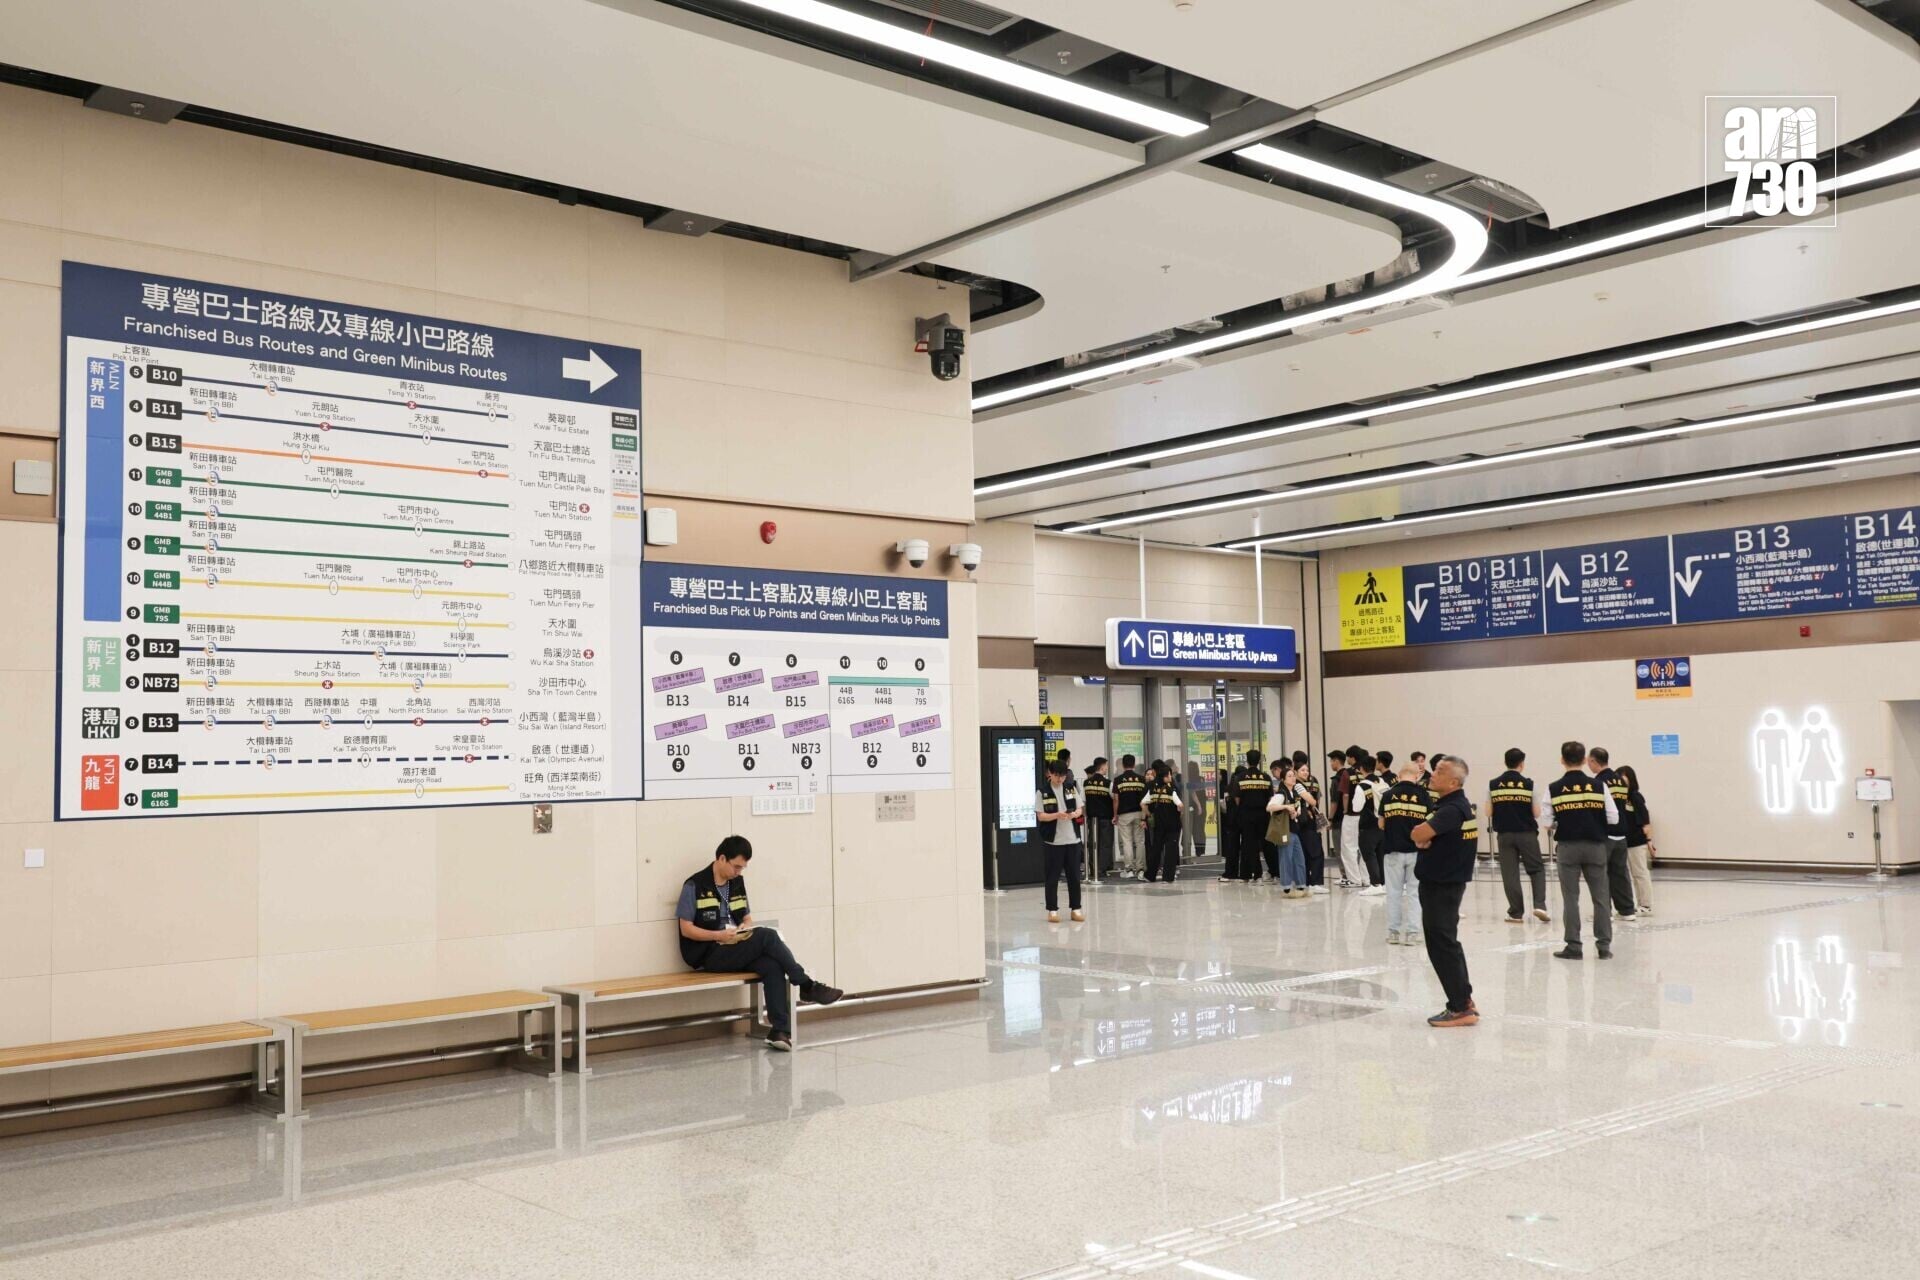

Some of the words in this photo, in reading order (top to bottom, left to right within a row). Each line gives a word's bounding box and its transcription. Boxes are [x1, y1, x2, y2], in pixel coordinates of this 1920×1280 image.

[141, 282, 495, 358] 專營巴士路線及專線小巴路線
[124, 316, 217, 343] Franchised
[223, 329, 254, 347] Bus
[259, 335, 314, 356] Routes
[320, 344, 348, 361] and
[353, 348, 396, 367] Green
[401, 355, 455, 375] Minibus
[459, 363, 508, 382] Routes
[109, 362, 120, 390] NTW
[152, 368, 177, 382] B10
[89, 360, 105, 410] 新界西
[152, 402, 177, 416] B11
[151, 436, 177, 449] B15
[131, 470, 141, 479] 11
[130, 505, 142, 514] 10
[549, 500, 576, 512] 屯門站
[154, 512, 173, 520] 44B1
[1855, 510, 1917, 540] B14
[1734, 525, 1791, 553] B13
[158, 546, 167, 554] 78
[1490, 555, 1531, 580] B11
[1580, 550, 1630, 576] B12
[128, 574, 141, 583] 10
[1438, 561, 1481, 585] B10
[152, 580, 172, 588] N44B
[669, 576, 928, 612] 專營巴士上客點及專線小巴上客點
[153, 606, 171, 614] GMB
[653, 602, 707, 615] Franchised
[709, 605, 728, 616] Bus
[731, 606, 751, 617] Pick
[753, 607, 767, 619] Up
[769, 608, 798, 619] Points
[800, 610, 817, 620] and
[819, 611, 845, 621] Green
[846, 612, 880, 623] Minibus
[882, 613, 899, 624] Pick
[901, 615, 912, 626] Up
[914, 617, 941, 626] Points
[1172, 631, 1246, 649] 專線小巴上客區
[105, 641, 116, 665] NTE
[149, 642, 174, 654] B12
[1173, 649, 1199, 660] Green
[1199, 650, 1231, 661] Minibus
[1231, 651, 1247, 661] Pick
[1248, 652, 1259, 664] Up
[1260, 652, 1278, 662] Area
[86, 639, 102, 688] 新界東
[144, 677, 178, 689] NB73
[538, 676, 587, 689] 沙田市中心
[528, 689, 541, 697] Sha
[556, 689, 574, 697] Town
[575, 689, 598, 697] Centre
[667, 695, 690, 706] B13
[728, 695, 750, 707] B14
[786, 695, 807, 707] B15
[84, 709, 119, 726] 港島
[148, 717, 174, 728] B13
[87, 726, 115, 739] HKI
[518, 723, 529, 731] Siu
[531, 723, 542, 731] Sai
[667, 744, 690, 756] B10
[738, 744, 760, 755] B11
[792, 742, 821, 754] NB73
[862, 742, 882, 754] B12
[912, 742, 931, 753] B12
[147, 758, 173, 770] B14
[84, 758, 101, 791] 九龍
[104, 758, 115, 784] KLN
[127, 795, 137, 804] 11
[151, 791, 169, 799] GMB
[1554, 802, 1604, 812] IMMIGRATION
